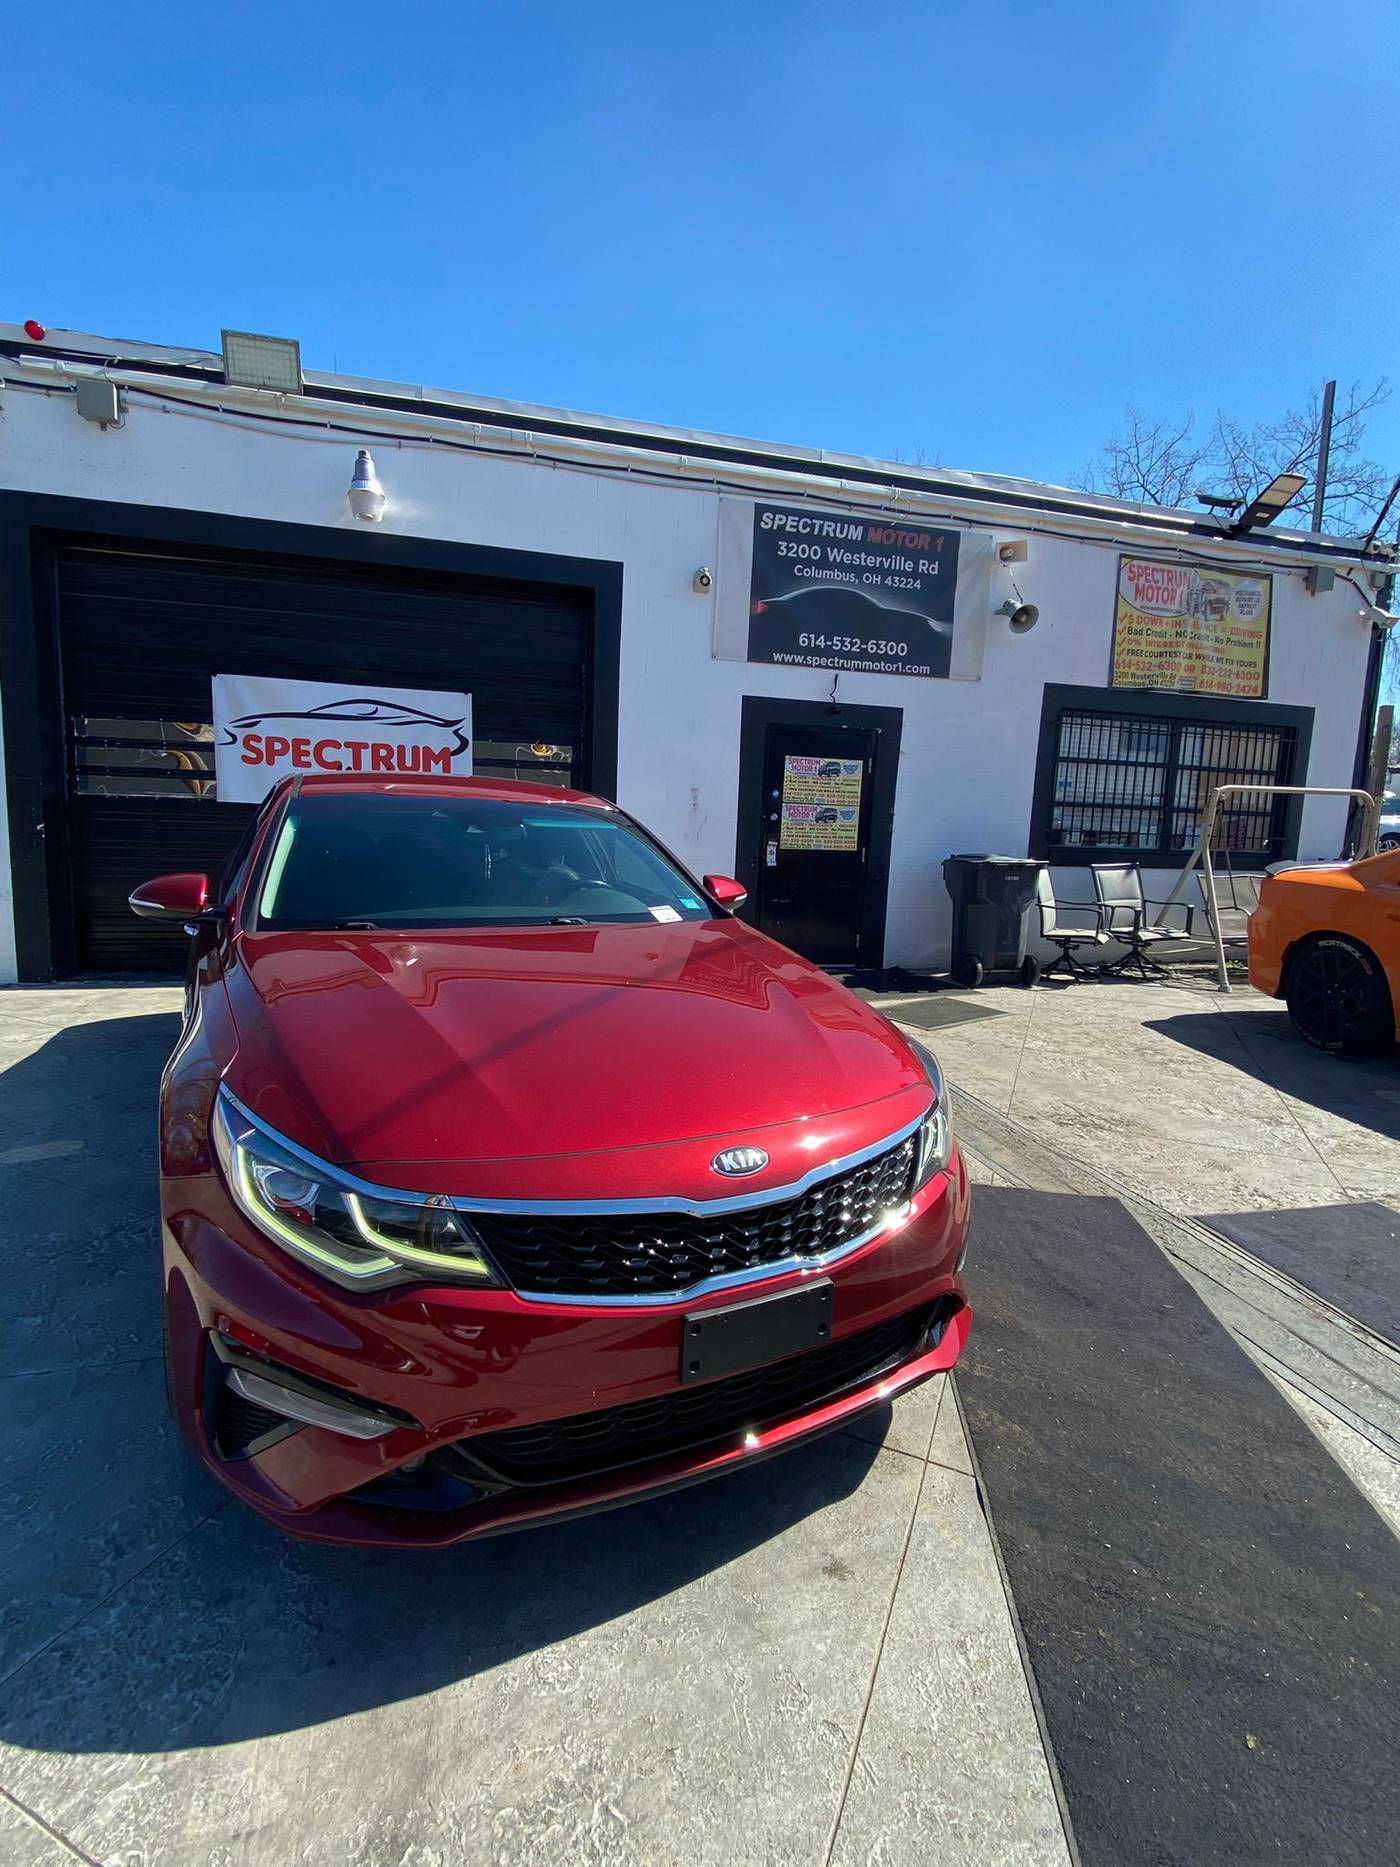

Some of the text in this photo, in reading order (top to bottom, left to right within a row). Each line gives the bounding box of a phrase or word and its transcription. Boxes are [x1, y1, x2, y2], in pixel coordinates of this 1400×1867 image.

[760, 512, 945, 552] SPECTRUM MOTOR 1
[777, 541, 939, 575] 3200 Westerville Rd
[794, 565, 921, 590] Columbus, OH 43224
[1128, 563, 1191, 590] SPECTRUM
[1135, 583, 1177, 606] MOTOR
[1127, 626, 1144, 636] Bad
[799, 633, 908, 656] 614-532-6300
[773, 652, 930, 675] www.spectrummotor1.com
[241, 733, 451, 773] SPECTRUM
[720, 1149, 763, 1171] KIA
